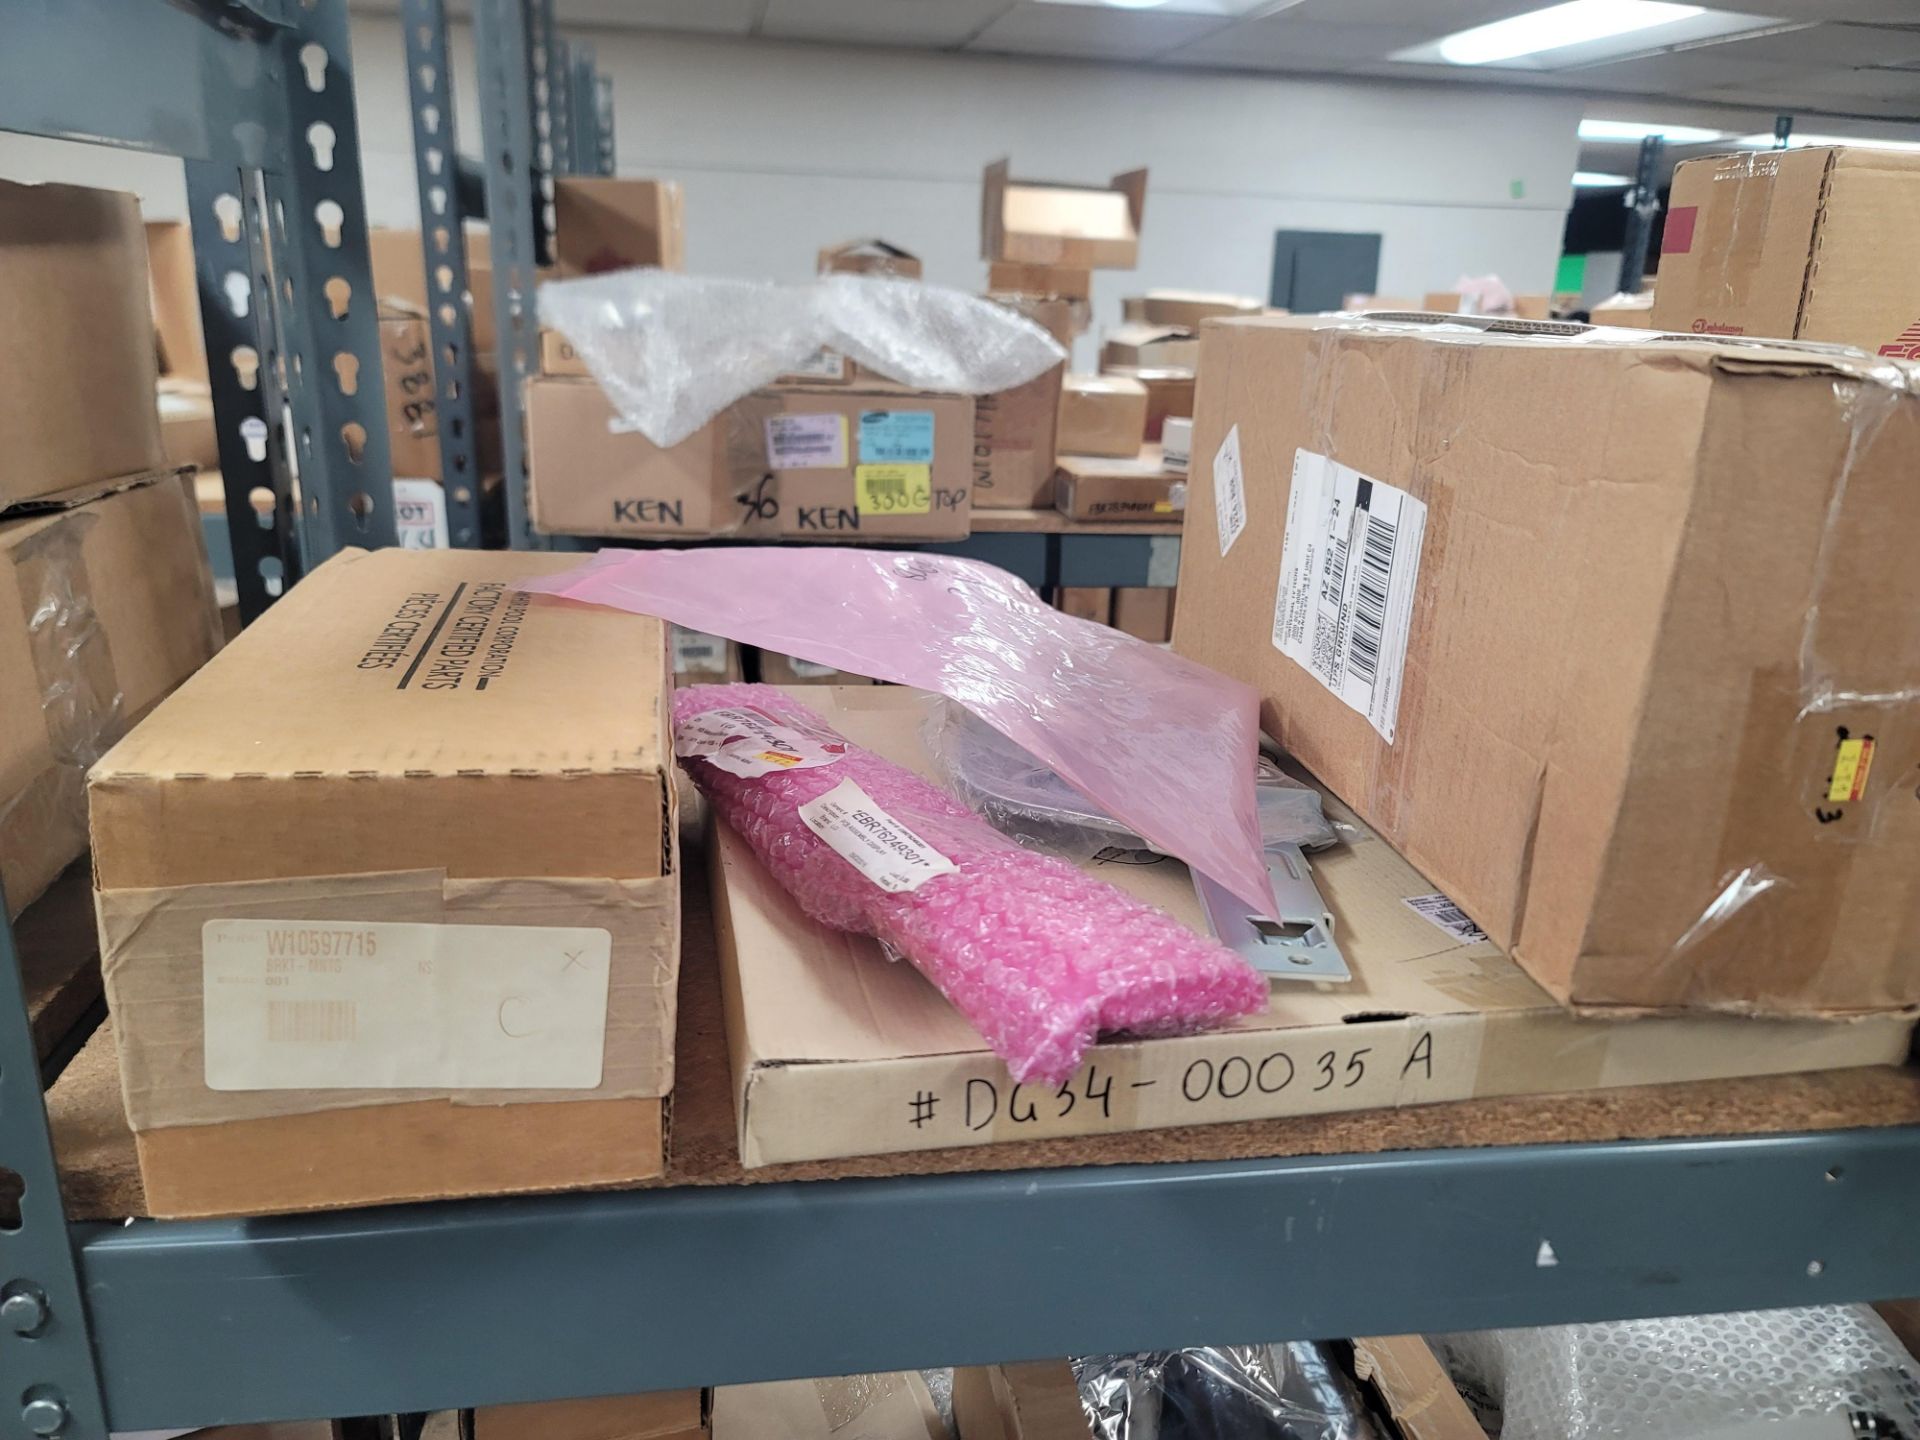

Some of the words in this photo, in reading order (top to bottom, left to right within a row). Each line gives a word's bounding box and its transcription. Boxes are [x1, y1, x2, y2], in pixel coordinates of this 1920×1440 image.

[613, 499, 683, 526] KEN
[797, 505, 859, 530] KEN
[394, 592, 445, 619] PIÈCES
[463, 582, 506, 616] FACTORY
[1321, 580, 1329, 601] AZ
[356, 620, 422, 669] CERTIFIÉES
[440, 616, 490, 657] CERTIFIED
[1335, 602, 1349, 658] GROUND
[477, 626, 519, 678] CORPORATION
[421, 659, 470, 690] PARTS
[1402, 1032, 1434, 1080] A
